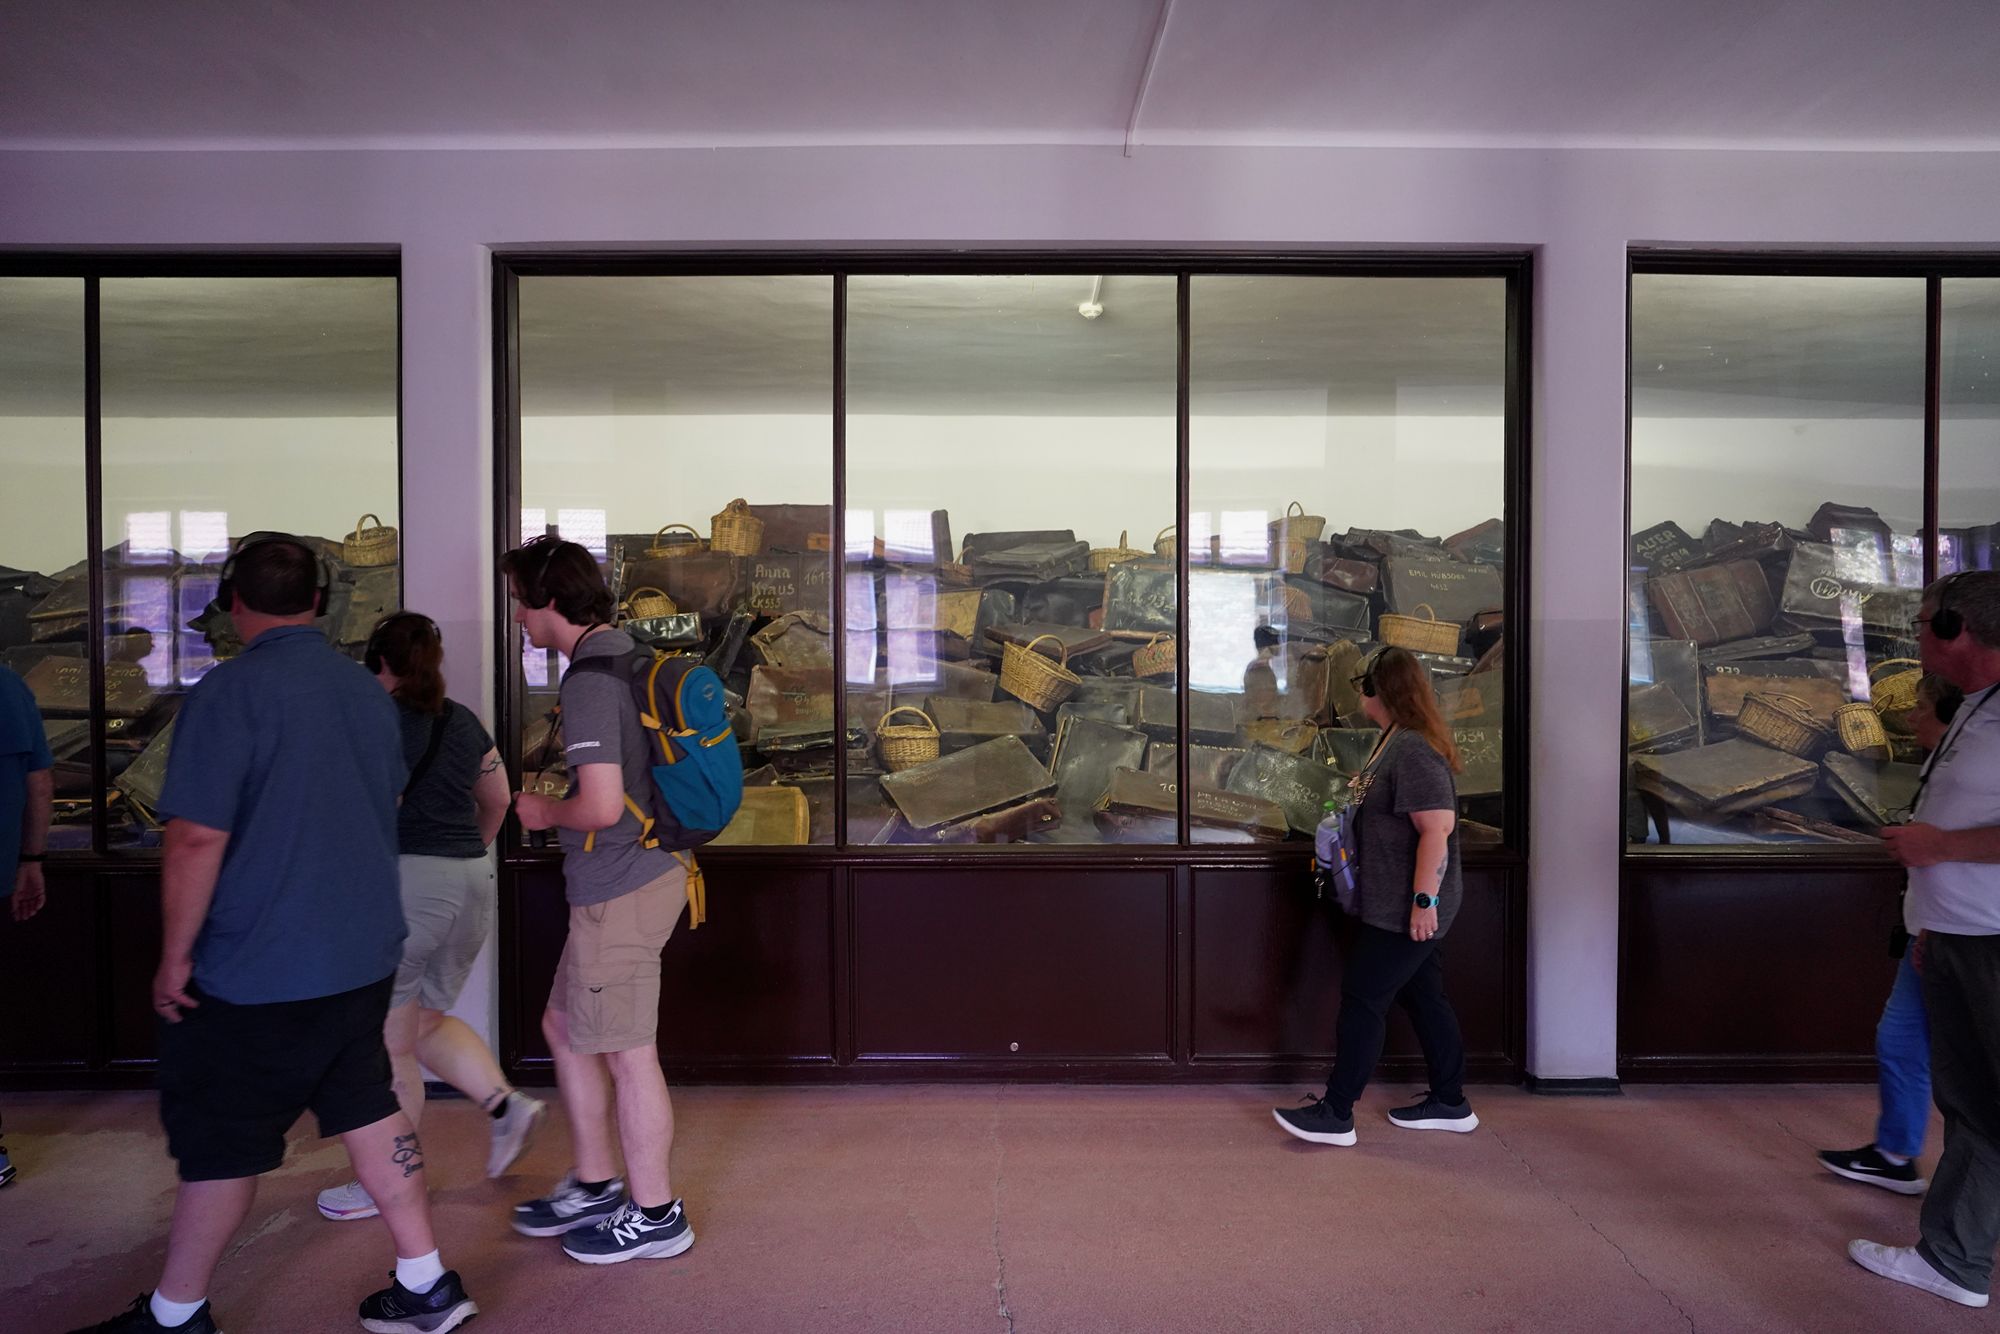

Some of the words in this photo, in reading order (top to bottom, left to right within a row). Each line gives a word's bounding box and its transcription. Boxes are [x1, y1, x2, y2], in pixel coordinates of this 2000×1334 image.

[1636, 530, 1676, 553] ALTER
[755, 563, 791, 579] Anna
[751, 581, 795, 596] Kraus
[612, 1222, 639, 1246] N
[380, 1296, 406, 1318] N
